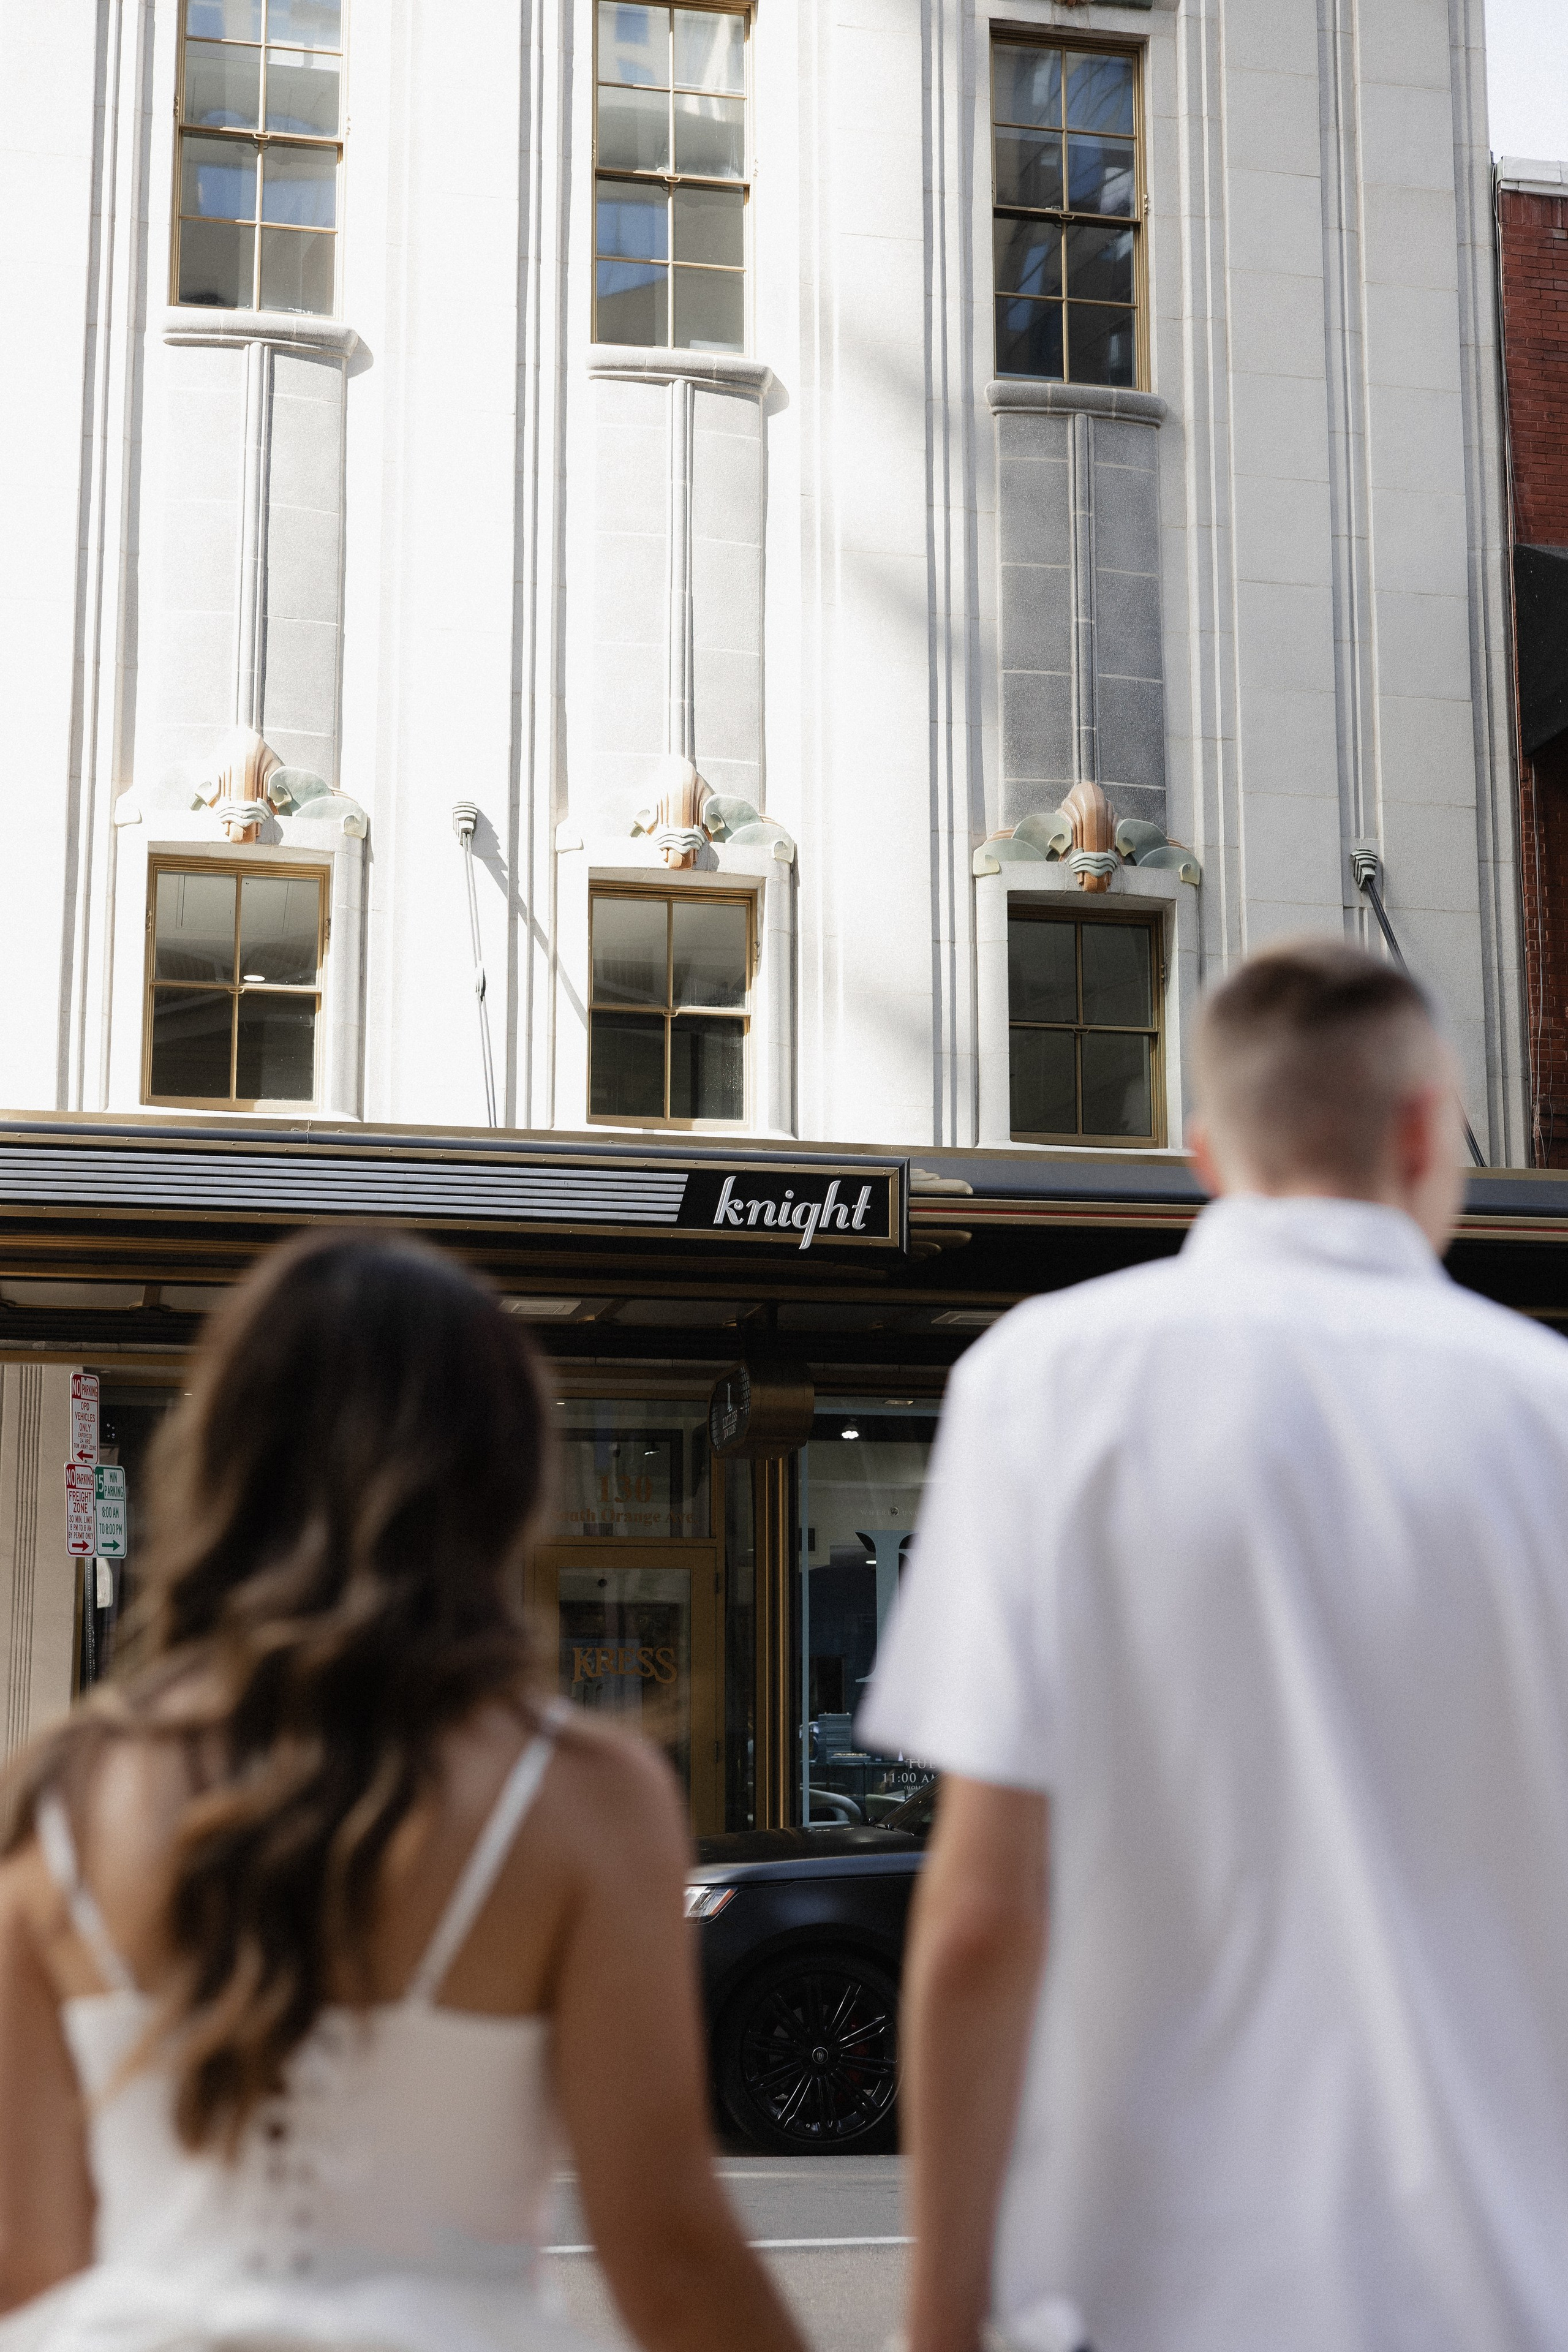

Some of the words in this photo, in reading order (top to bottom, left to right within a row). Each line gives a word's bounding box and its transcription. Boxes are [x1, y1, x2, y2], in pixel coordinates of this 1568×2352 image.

[714, 1176, 872, 1250] knight
[72, 1379, 81, 1396] NO
[82, 1384, 98, 1397] PARKING
[80, 1402, 90, 1411] OPD
[75, 1411, 96, 1423] VEHICLES
[79, 1423, 91, 1432] ONLY
[66, 1469, 76, 1486] NO
[77, 1473, 93, 1486] PARKING
[109, 1471, 118, 1483] MIN
[95, 1474, 104, 1493] 15
[597, 1474, 653, 1503] 130
[69, 1491, 92, 1502] FREIGHT
[104, 1485, 124, 1498] PARKING
[73, 1502, 88, 1513] ZONE
[102, 1506, 112, 1518] 8:00
[113, 1507, 119, 1518] AM
[601, 1507, 662, 1527] Orange
[99, 1523, 105, 1534] TO
[105, 1523, 115, 1535] 8:00
[116, 1525, 123, 1535] PM
[572, 1646, 678, 1684] KRESS
[882, 1773, 916, 1783] 11:00
